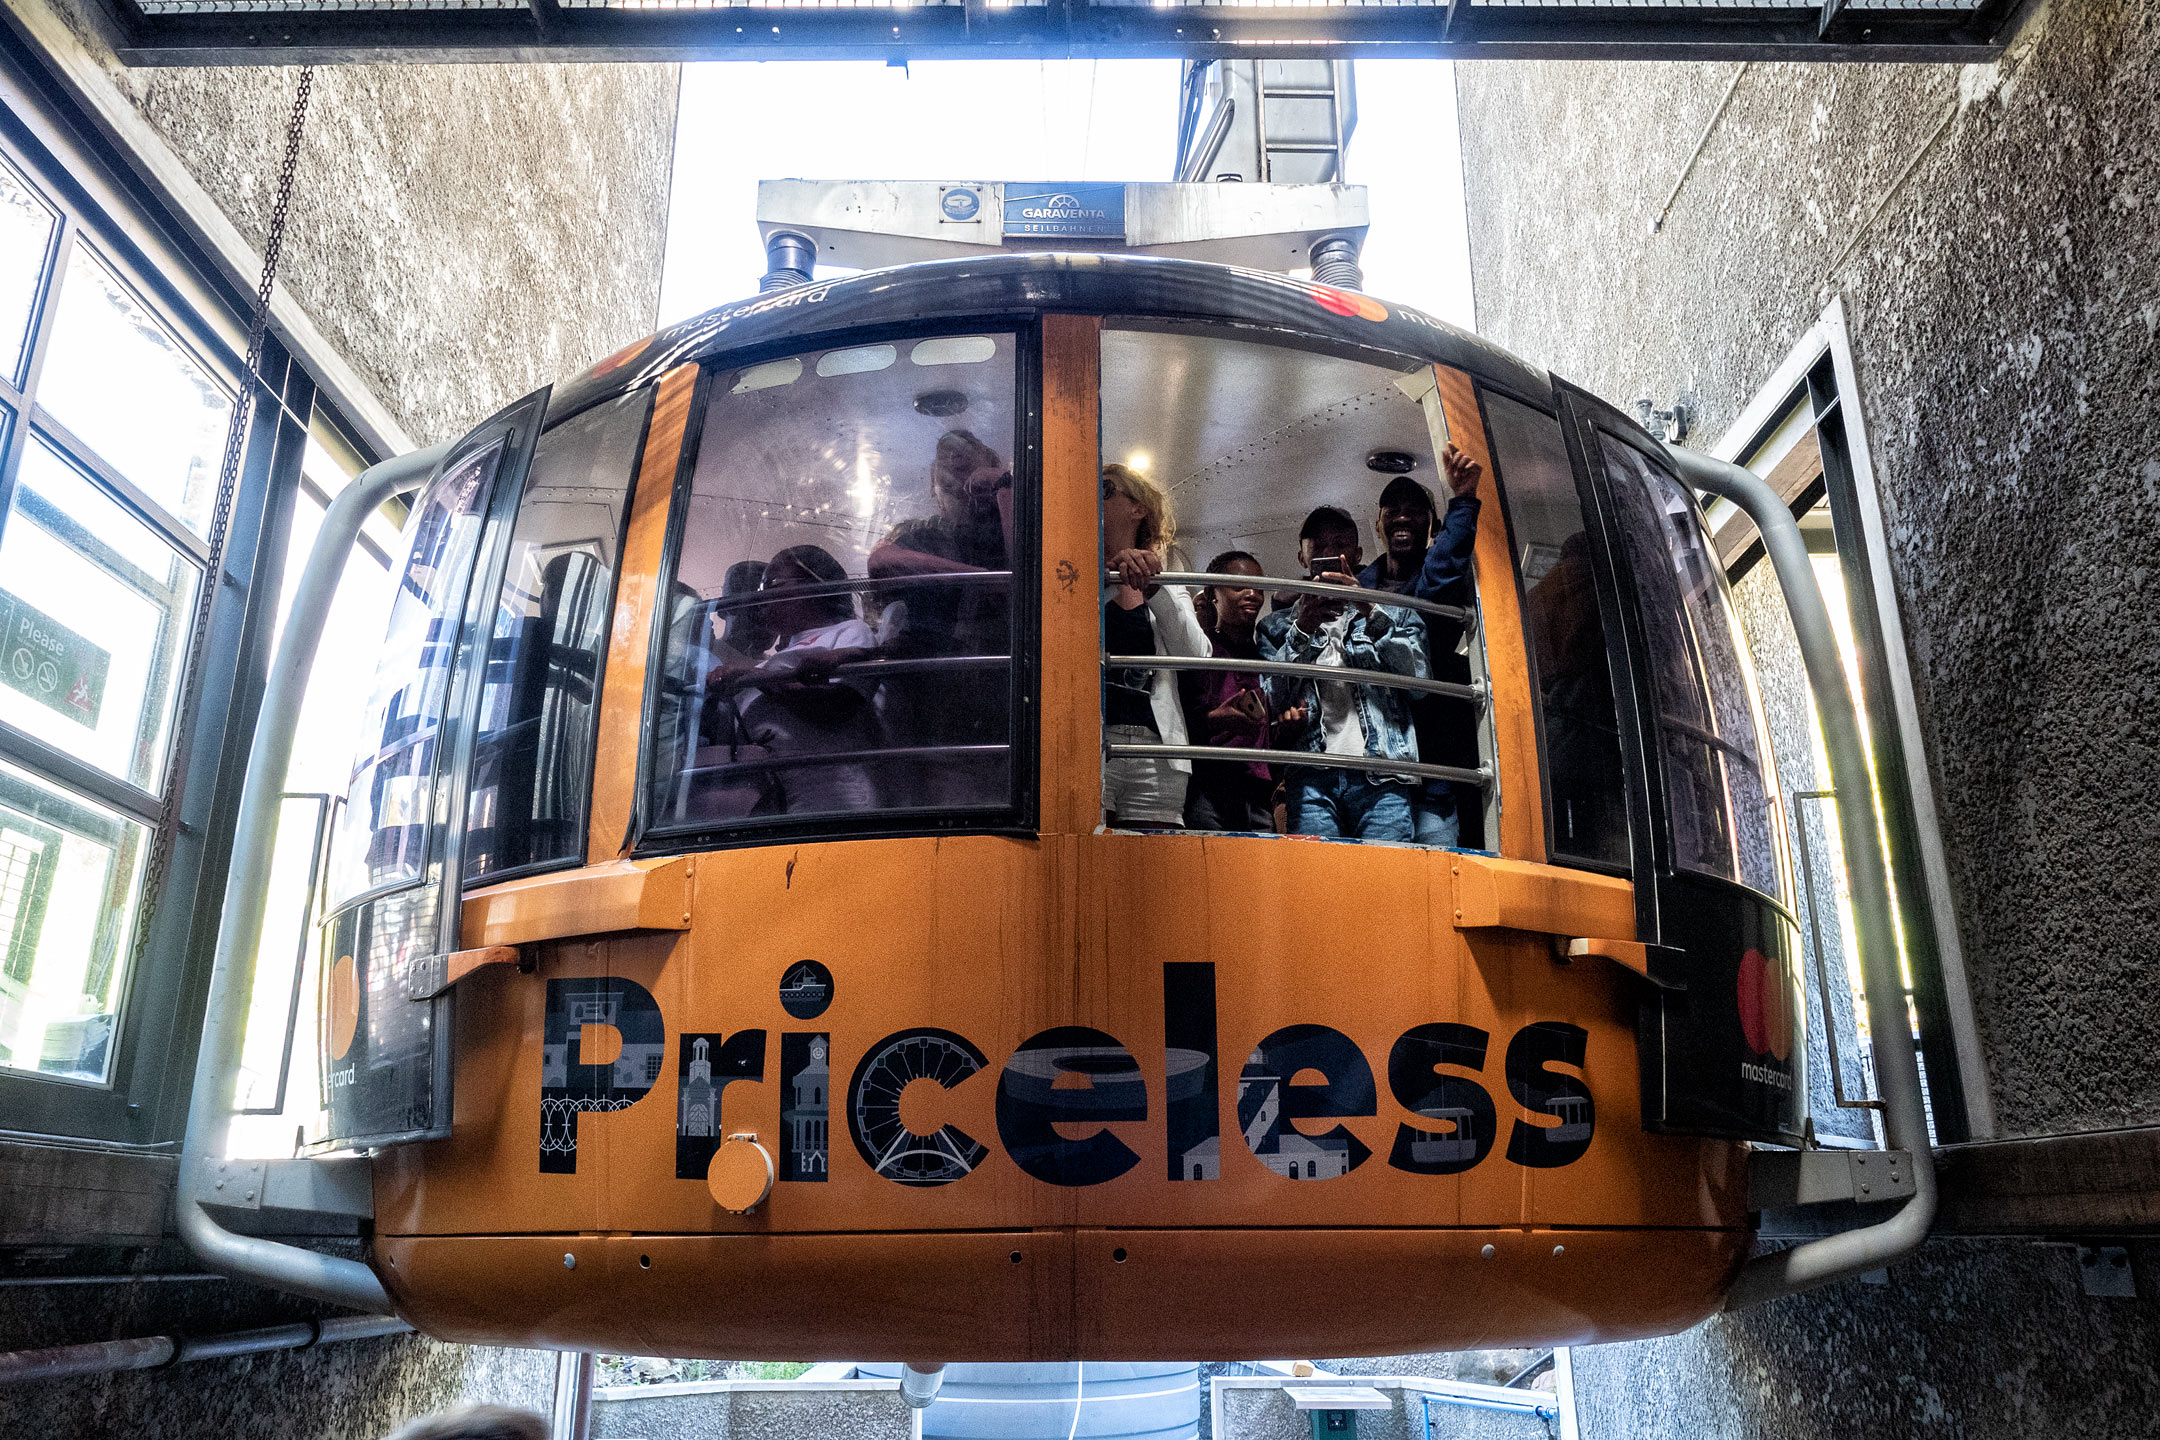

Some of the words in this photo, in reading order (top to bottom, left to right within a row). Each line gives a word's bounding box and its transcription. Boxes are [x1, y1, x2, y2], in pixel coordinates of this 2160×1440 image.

[1021, 207, 1106, 219] GARAVENTA
[1023, 223, 1105, 233] SEILBAHNEN
[19, 616, 65, 657] Please
[538, 959, 1595, 1188] Priceless
[1741, 1061, 1792, 1091] mastercard
